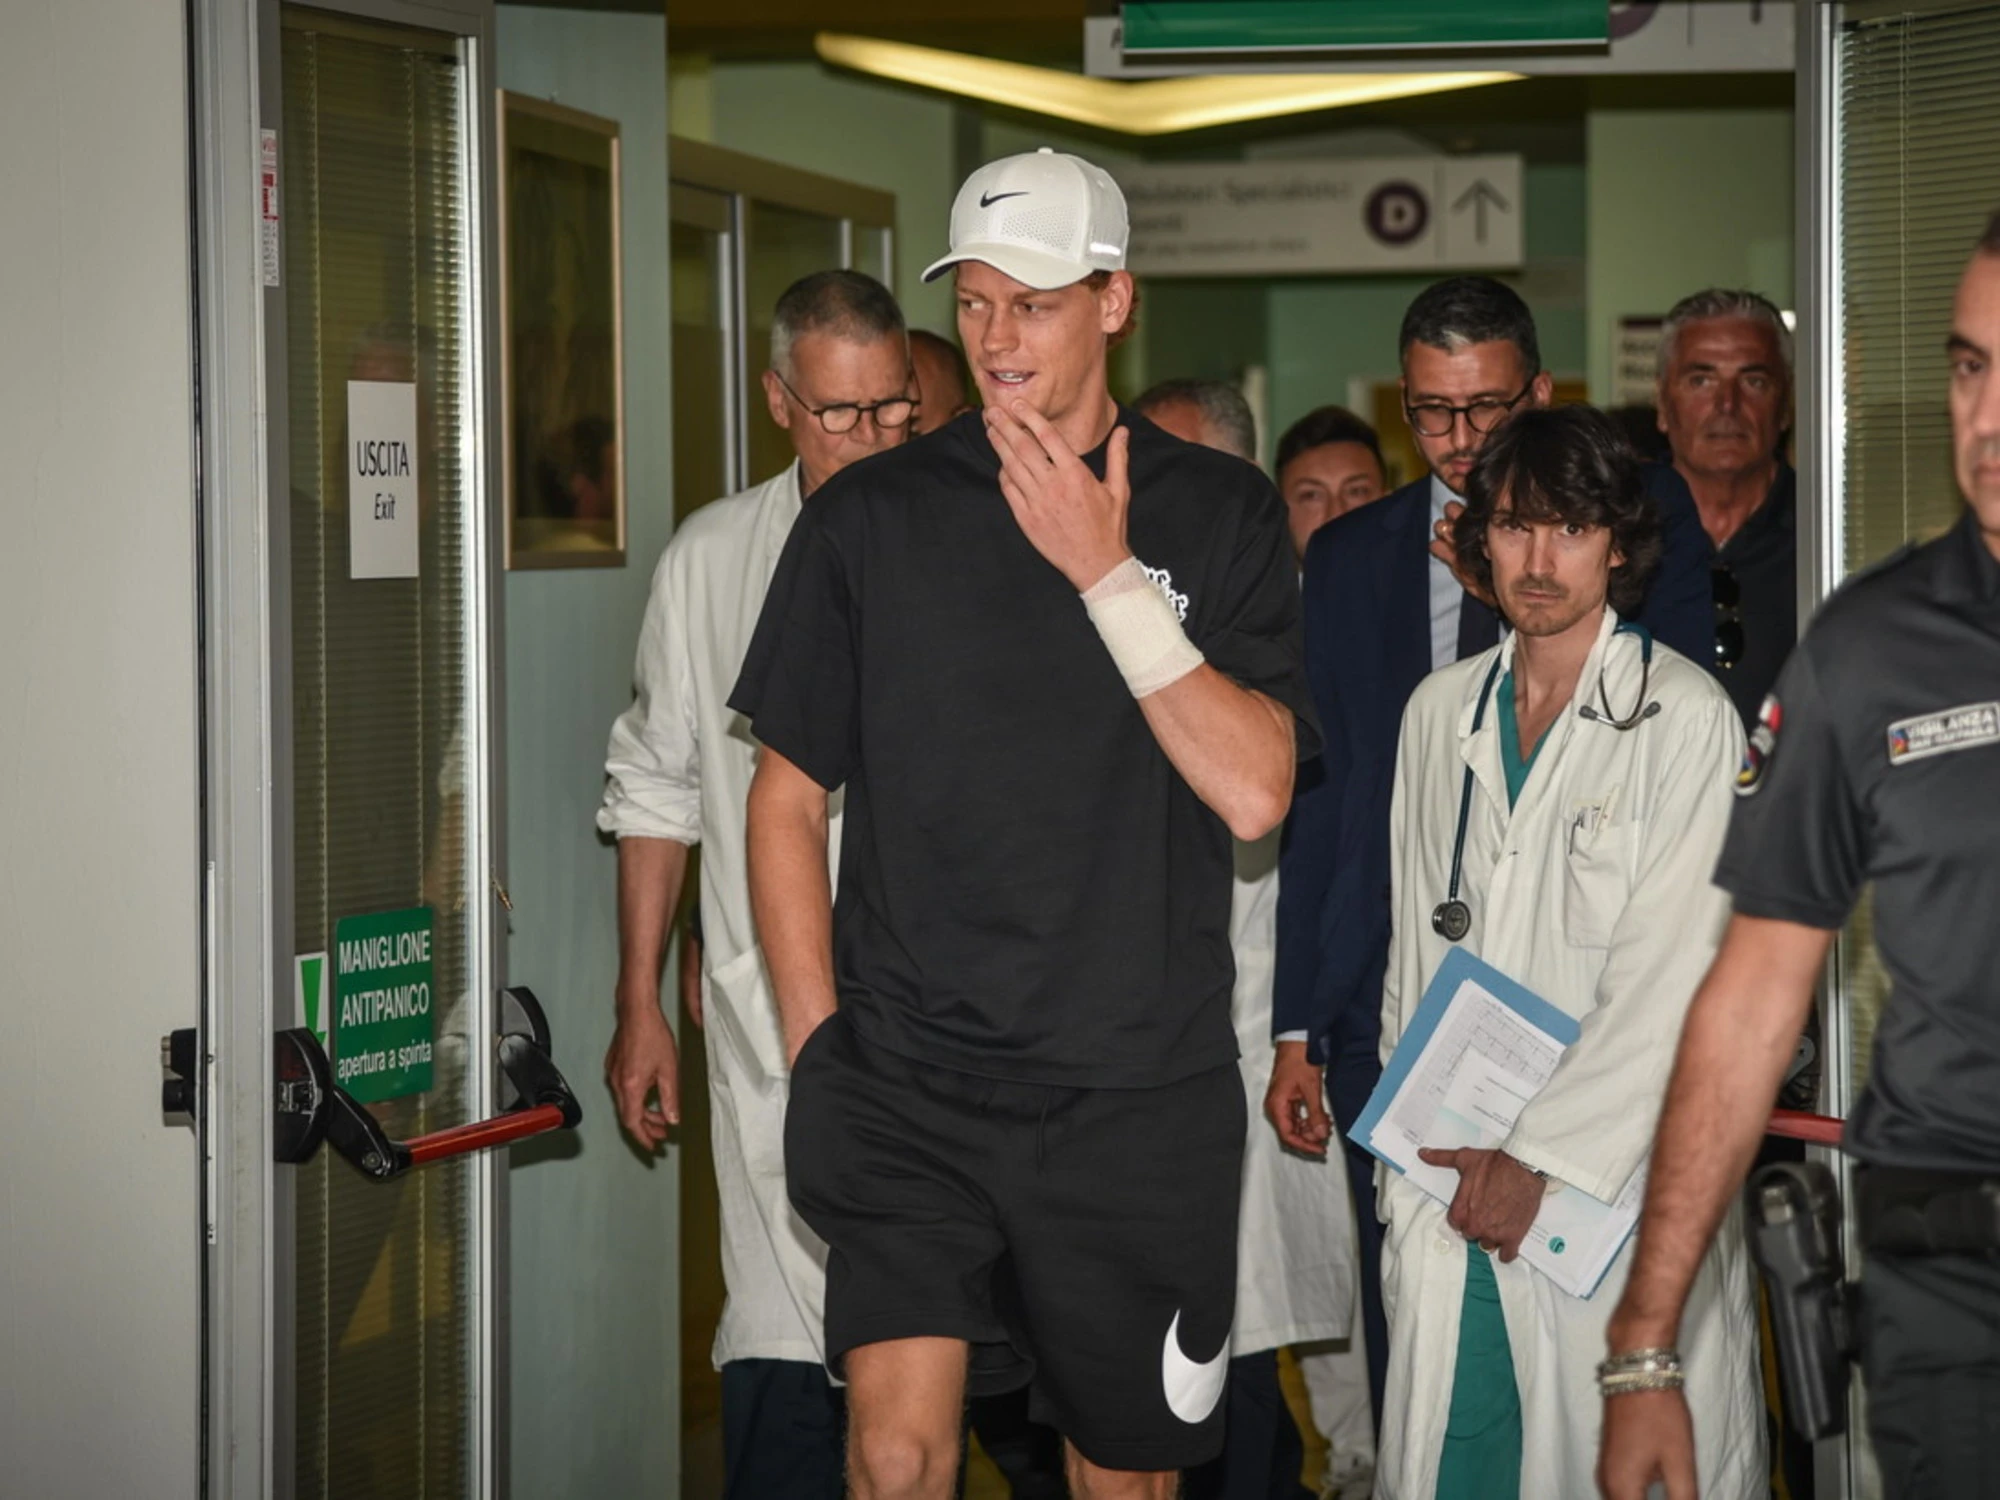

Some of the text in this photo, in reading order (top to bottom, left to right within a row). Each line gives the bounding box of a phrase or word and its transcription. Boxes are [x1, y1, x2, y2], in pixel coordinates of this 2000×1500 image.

[356, 441, 410, 477] USCITA
[374, 492, 396, 520] Exit
[339, 930, 430, 974] MANIGLIONE
[340, 982, 430, 1028] ANTIPANICO
[338, 1039, 432, 1084] apertura a spinta
